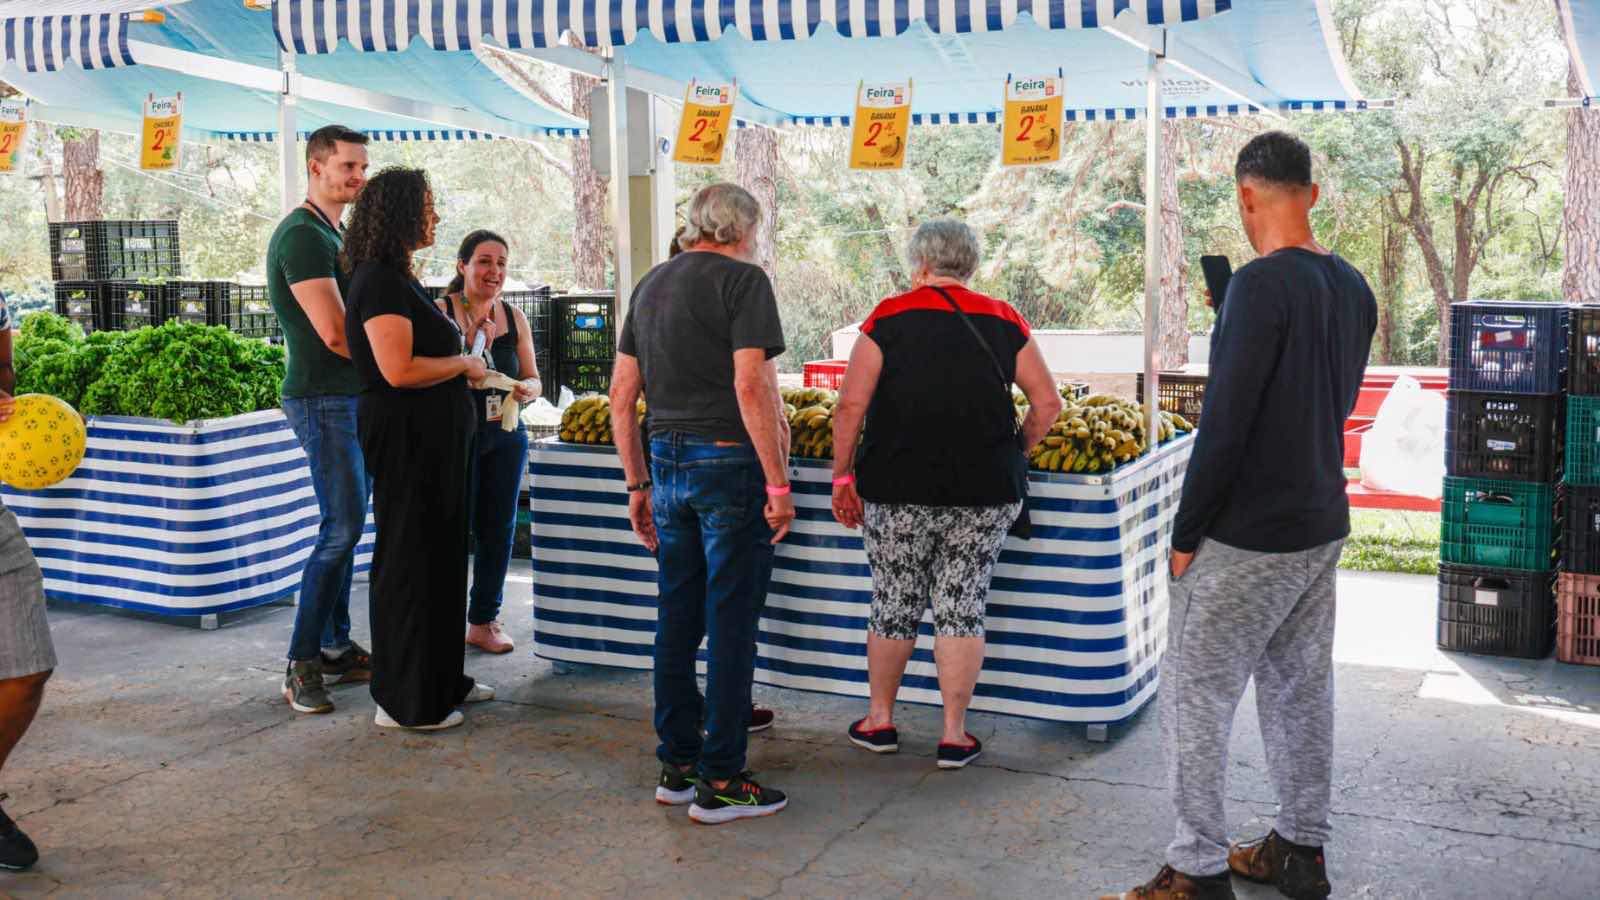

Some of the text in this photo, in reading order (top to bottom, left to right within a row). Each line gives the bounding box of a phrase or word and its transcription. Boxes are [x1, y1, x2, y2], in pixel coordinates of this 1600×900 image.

[1014, 79, 1045, 91] Feira
[695, 86, 721, 96] Feira
[866, 87, 895, 98] Feira
[151, 101, 172, 110] Feira
[1020, 104, 1048, 113] BANANA
[870, 112, 897, 120] BANANA
